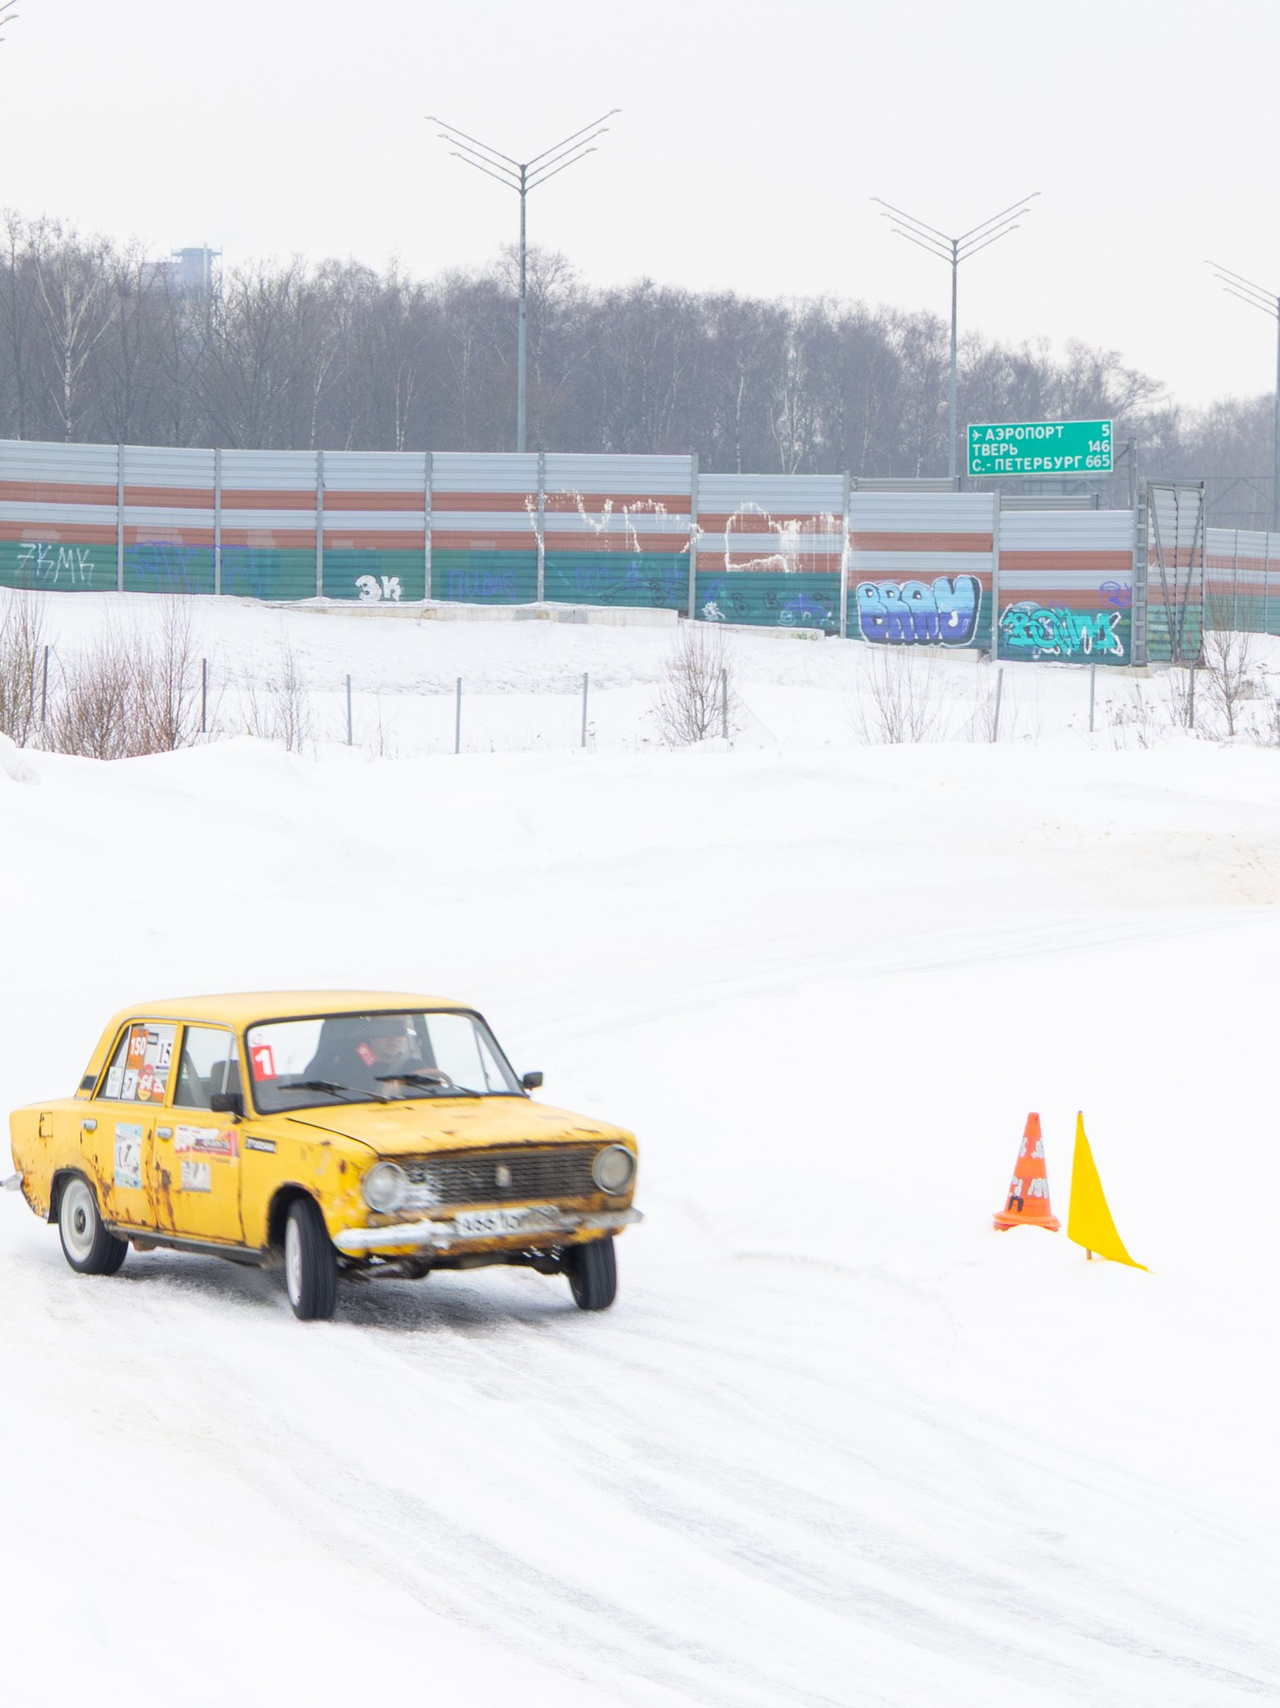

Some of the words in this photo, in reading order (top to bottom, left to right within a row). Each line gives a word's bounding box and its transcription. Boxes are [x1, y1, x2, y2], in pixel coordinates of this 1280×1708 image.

[985, 426, 1064, 440] АЭРОПОРТ
[1101, 424, 1110, 437] 5
[972, 443, 1018, 456] ТВЕРЬ
[1088, 440, 1110, 453] 146
[1085, 455, 1110, 468] 665
[130, 1037, 147, 1056] 150
[255, 1048, 273, 1076] 1
